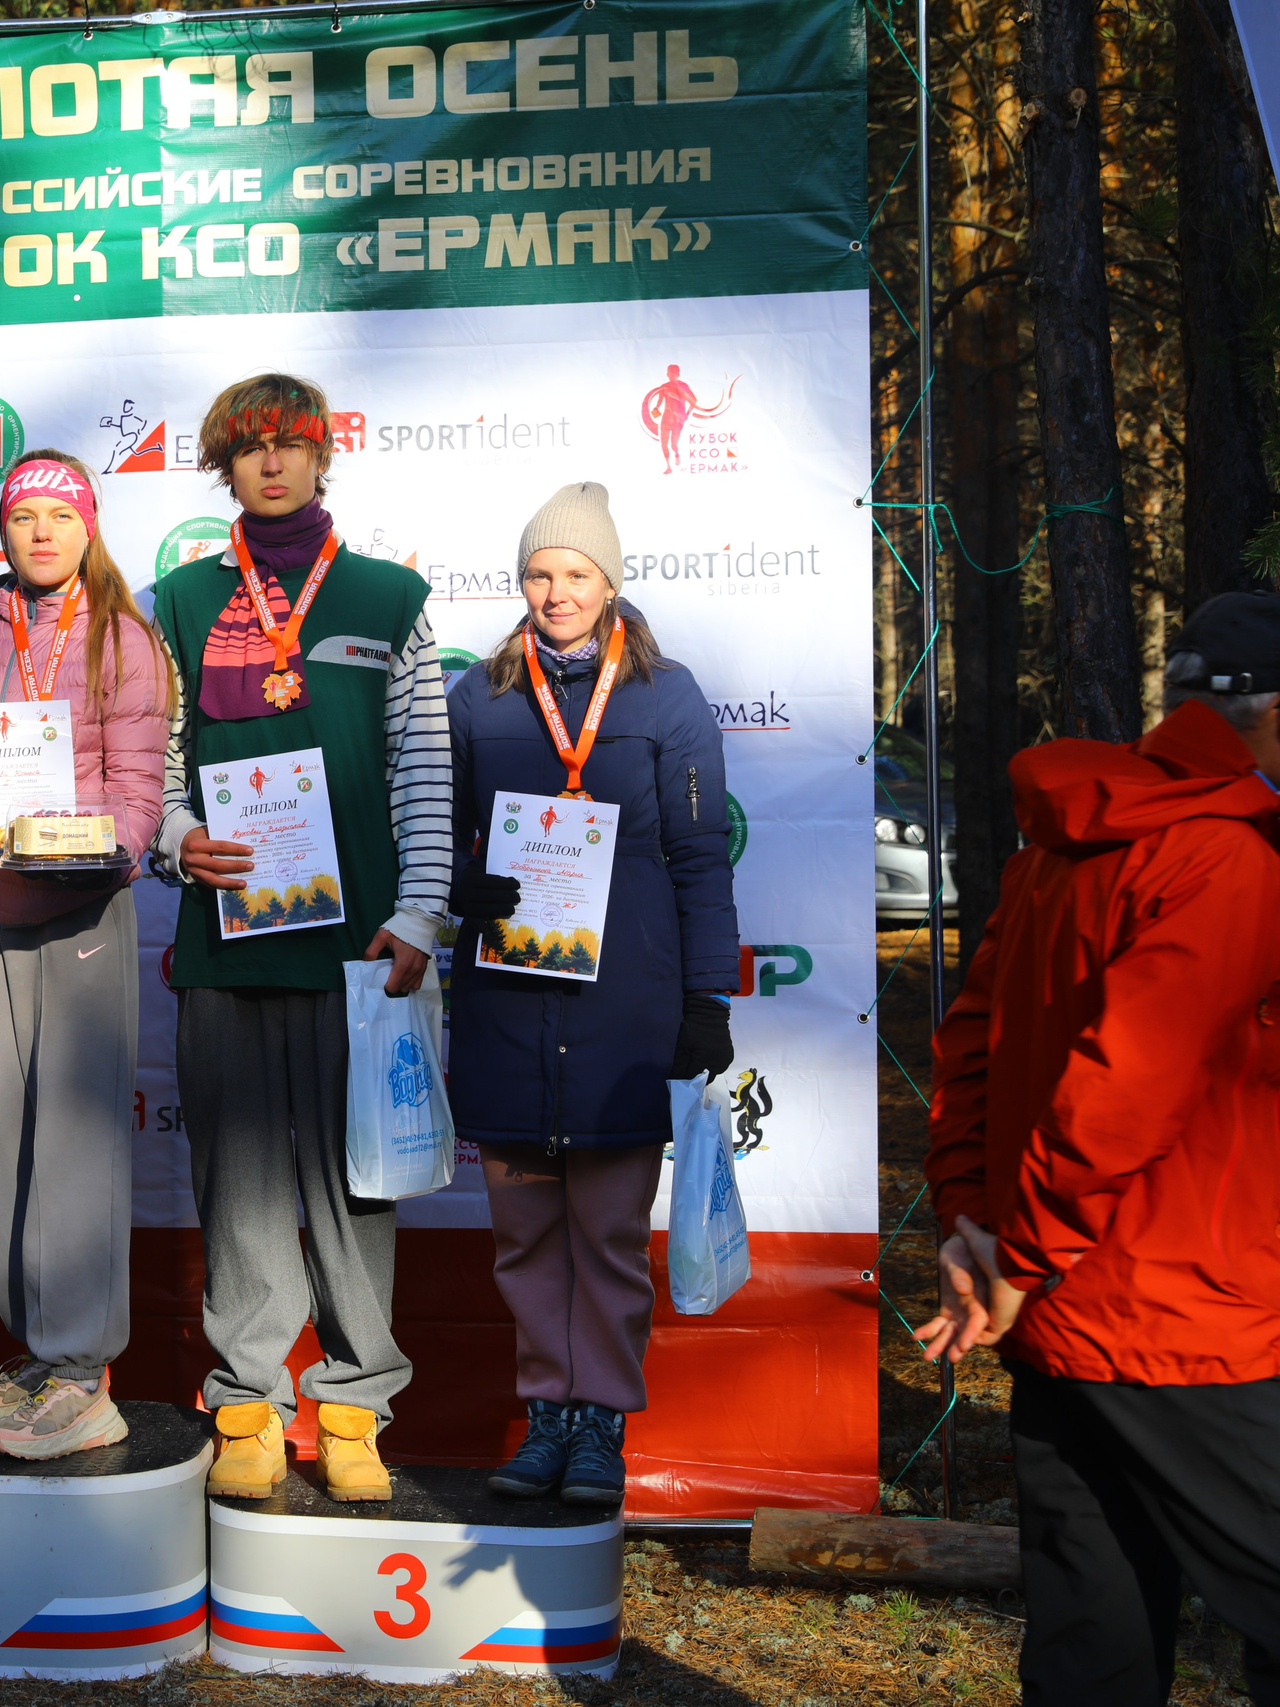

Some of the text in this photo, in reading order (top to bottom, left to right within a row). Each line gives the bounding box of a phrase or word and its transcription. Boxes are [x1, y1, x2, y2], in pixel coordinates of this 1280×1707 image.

[365, 29, 738, 119] ОСЕНЬ
[293, 147, 711, 200] СОРЕВНОВАНИЯ
[142, 222, 300, 279] КСО
[337, 206, 712, 273] «ЕРМАК»
[378, 413, 571, 452] SPORTident
[689, 432, 737, 444] КУБОК
[689, 448, 720, 459] КСО
[160, 530, 183, 570] ФЕДЕРАЦИЯ
[623, 541, 821, 582] SPORTident
[249, 568, 276, 630] ЗОЛОТАЯ ОСЕНЬ
[299, 560, 330, 616] ЗОЛОТАЯ ОСЕНЬ
[707, 581, 780, 597] siberia
[25, 648, 33, 672] ОСЕНЬ
[45, 630, 68, 694] ЗОЛОТАЯ ОСЕНЬ
[285, 675, 295, 687] 3
[589, 662, 617, 731] ЗОЛОТАЯ ОСЕНЬ
[542, 684, 571, 749] ЗОЛОТАЯ ОСЕНЬ
[302, 763, 321, 772] Ермак
[239, 799, 298, 818] ДИПЛОМ
[246, 816, 297, 828] НАГРАЖДАЕТСЯ
[274, 831, 296, 840] место
[520, 840, 582, 858] ДИПЛОМ
[524, 857, 576, 869] НАГРАЖДАЕТСЯ
[373, 1552, 431, 1640] 3
